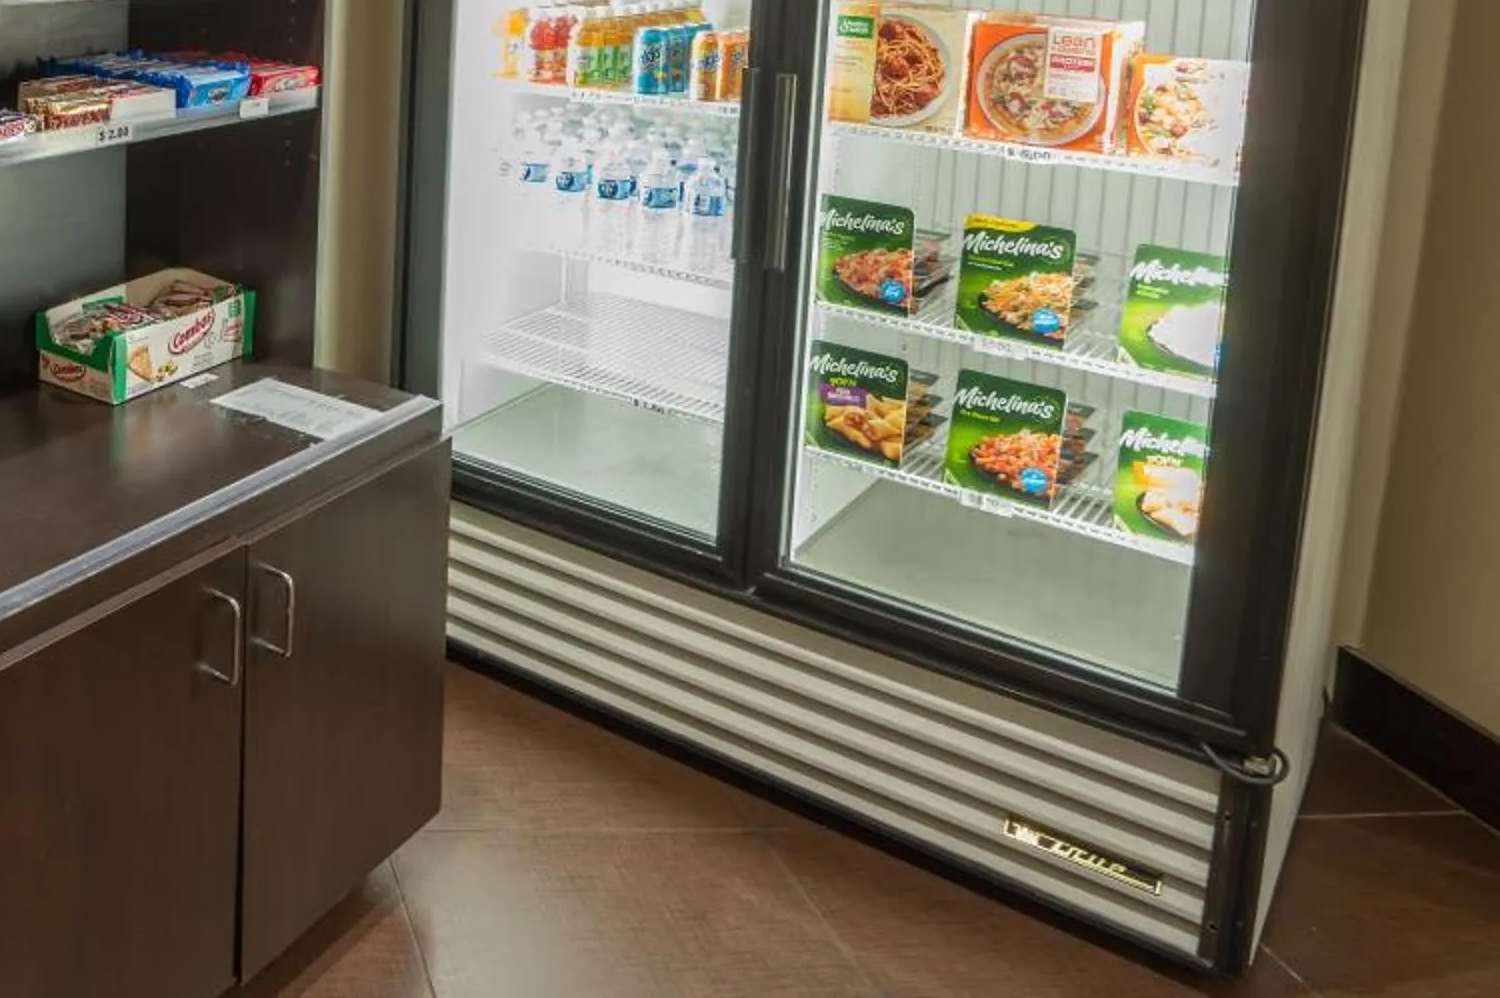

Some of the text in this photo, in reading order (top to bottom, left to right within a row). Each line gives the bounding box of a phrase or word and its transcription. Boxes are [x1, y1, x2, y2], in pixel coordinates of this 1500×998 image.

[820, 208, 905, 235] Michelina's
[963, 231, 1064, 260] Michelina's
[810, 353, 899, 383] Michelina's
[955, 386, 1055, 418] Michelina's
